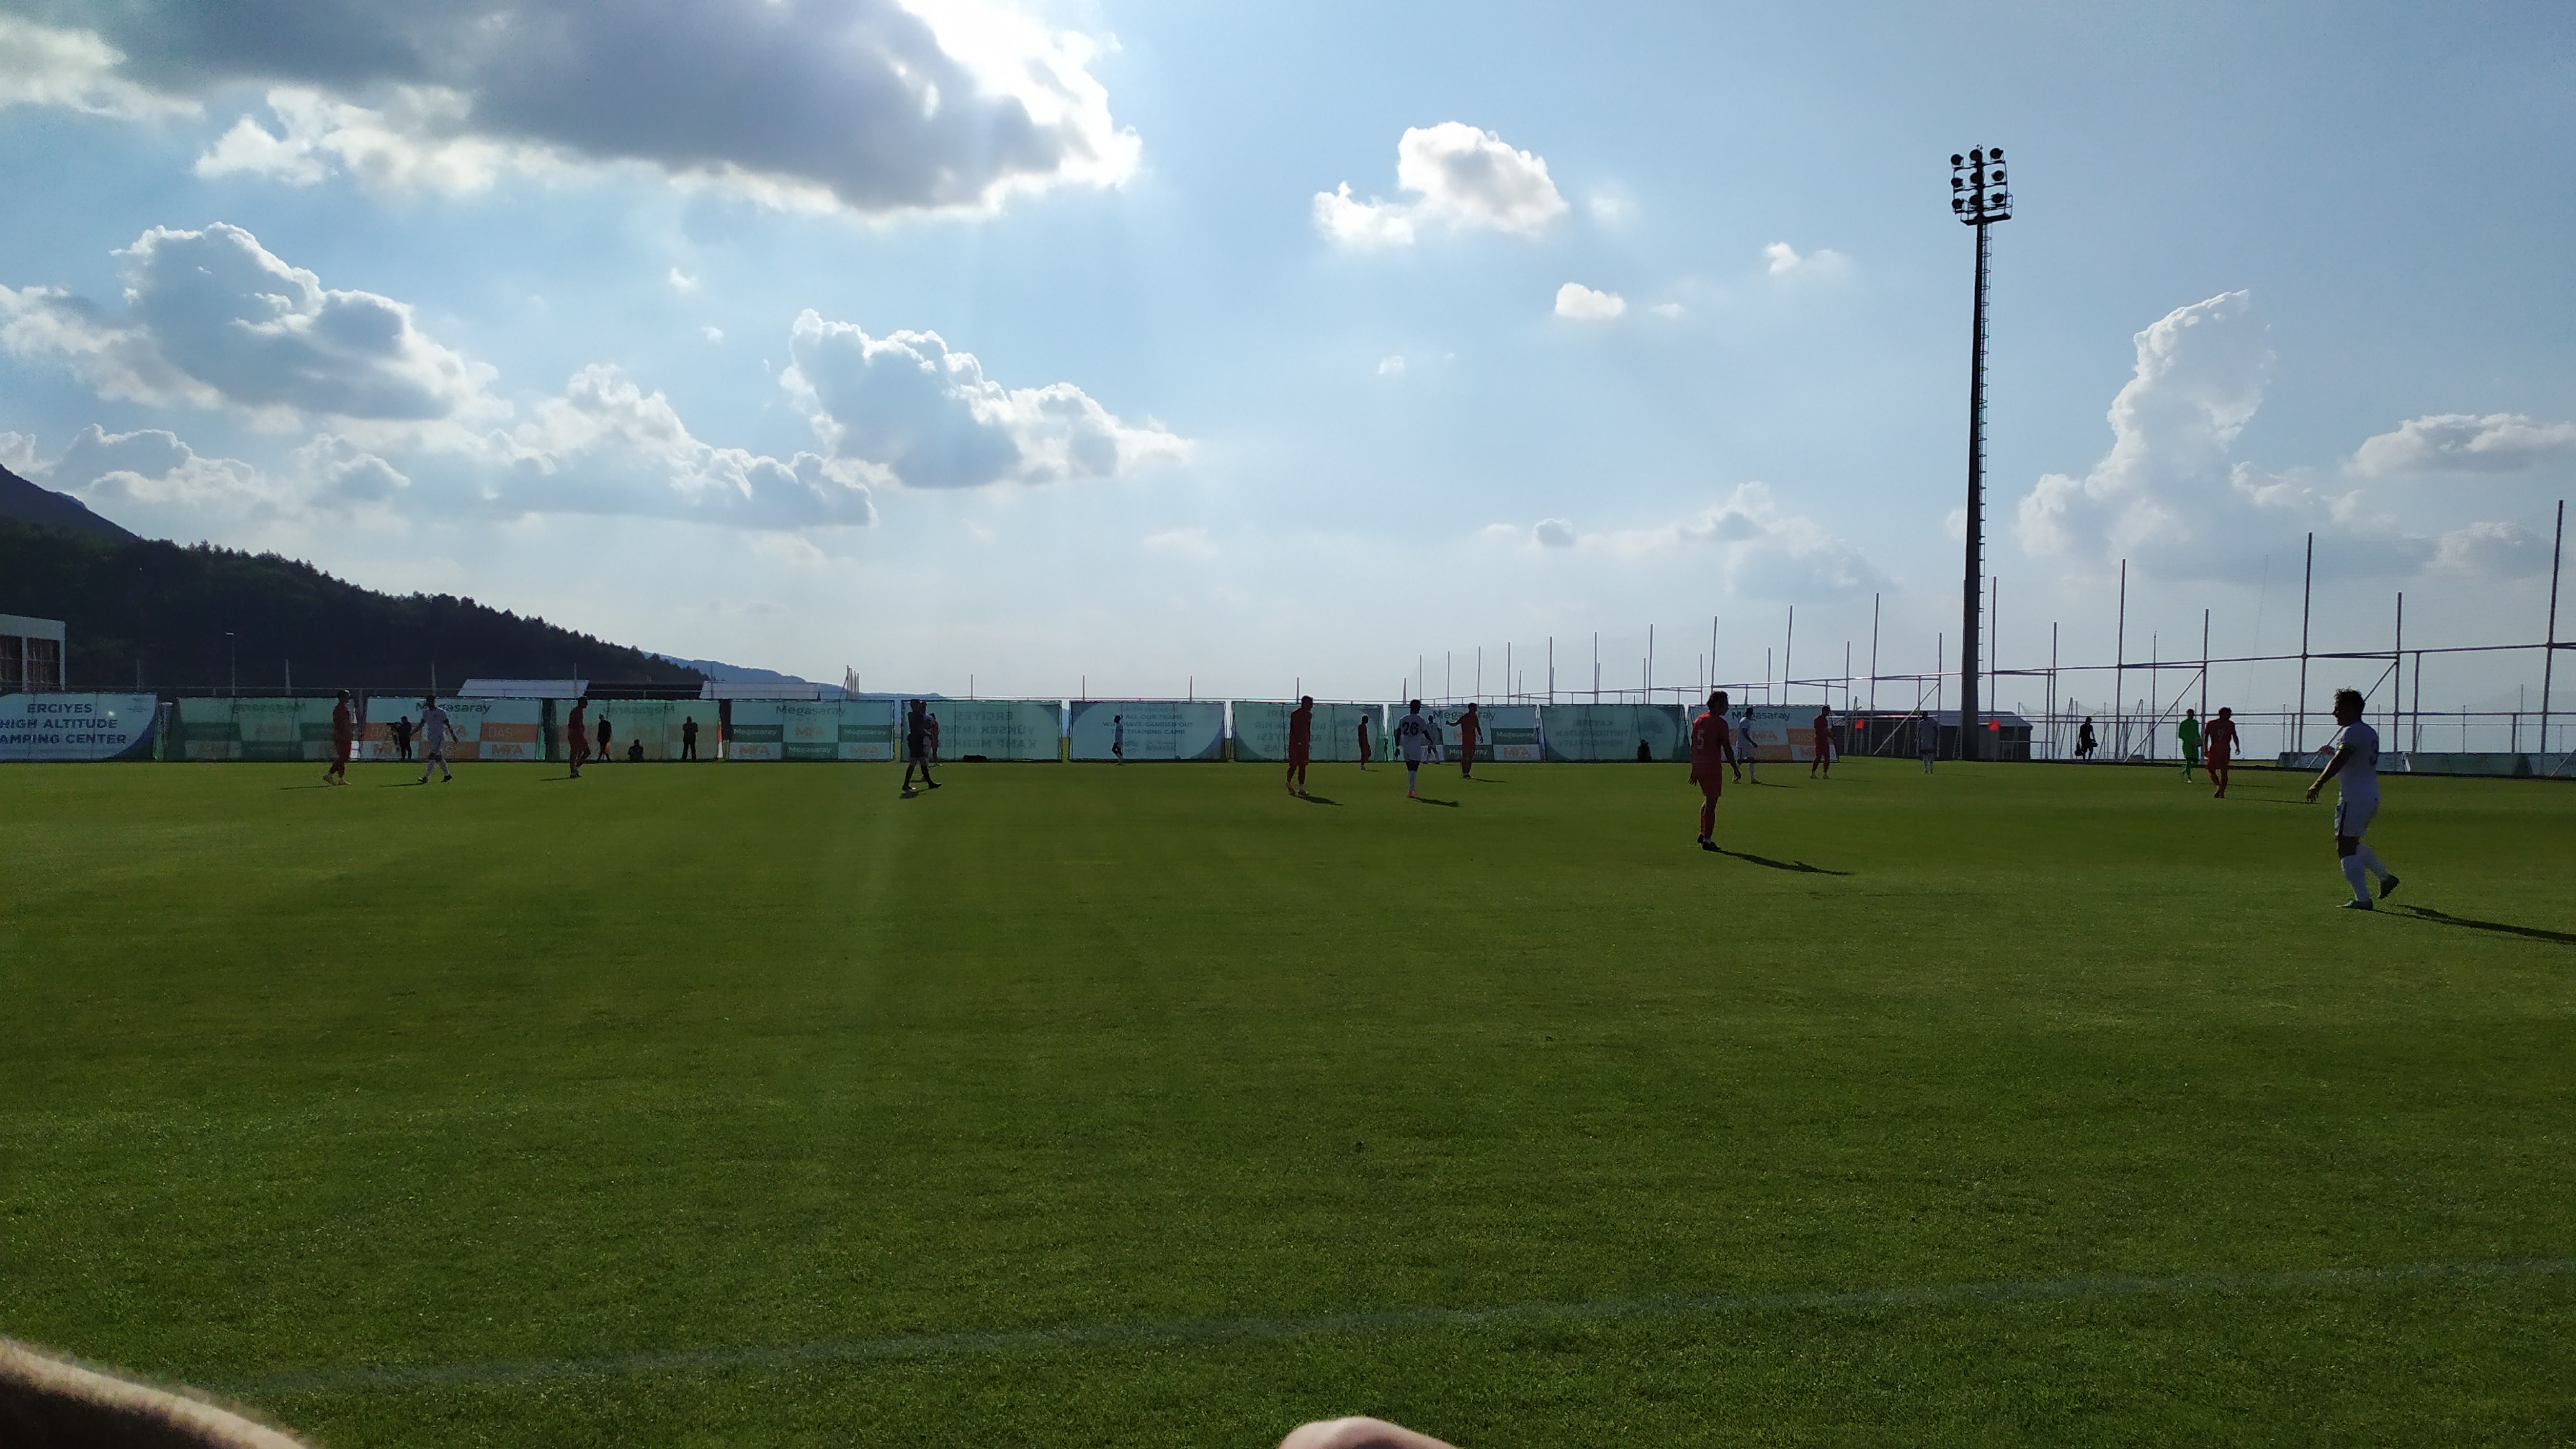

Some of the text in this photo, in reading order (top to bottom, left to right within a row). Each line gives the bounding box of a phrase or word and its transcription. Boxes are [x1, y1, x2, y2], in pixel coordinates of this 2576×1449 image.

[27, 703, 92, 713] ERCIYES
[415, 702, 492, 715] Masaray
[776, 705, 846, 717] Megasaray
[1433, 710, 1496, 721] Megaray
[1732, 711, 1790, 721] Mgasaray
[0, 719, 118, 728] HIGH ALTITUDE
[1401, 721, 1419, 736] 26
[0, 734, 126, 744] AMPING CENTER
[1696, 729, 1705, 750] 5
